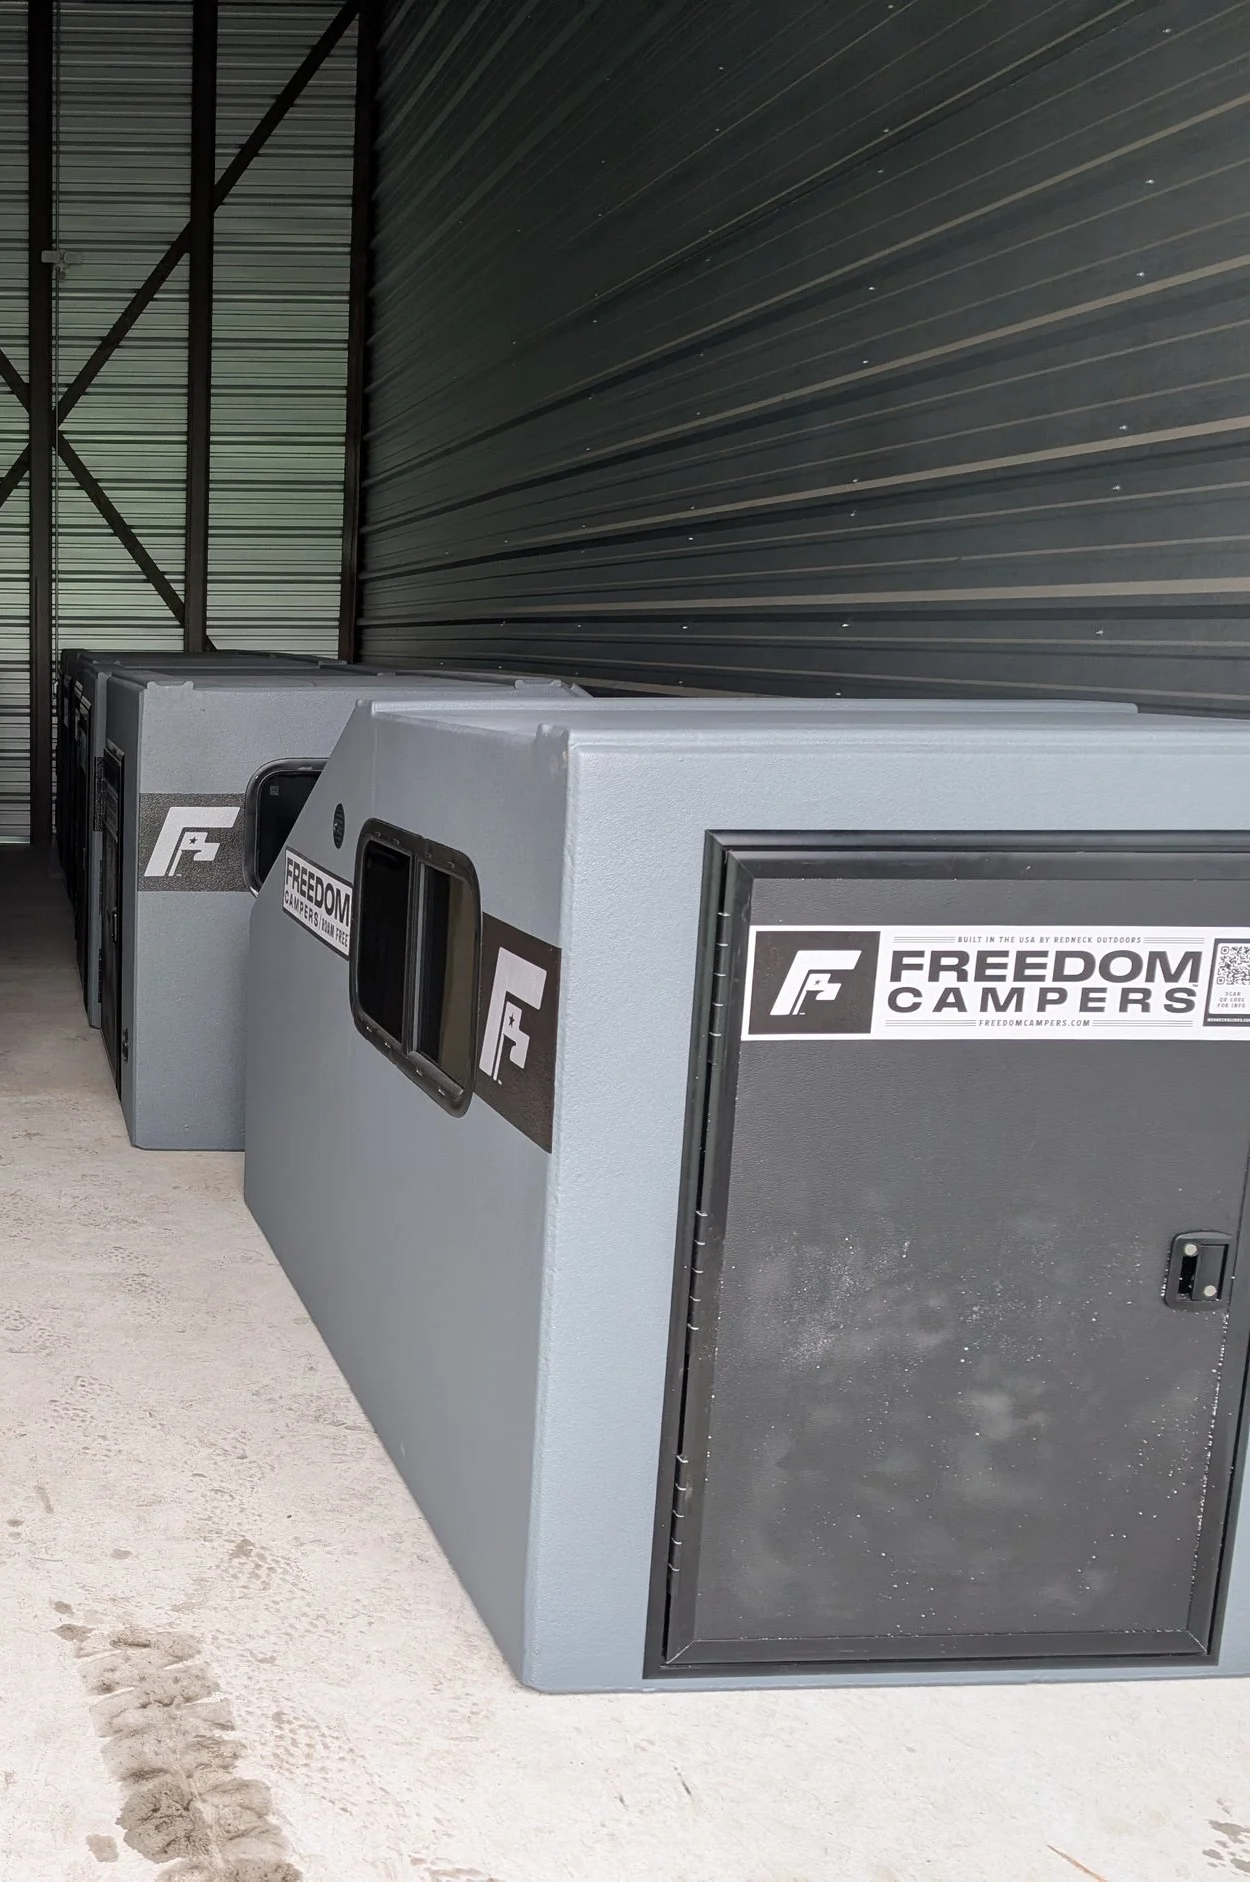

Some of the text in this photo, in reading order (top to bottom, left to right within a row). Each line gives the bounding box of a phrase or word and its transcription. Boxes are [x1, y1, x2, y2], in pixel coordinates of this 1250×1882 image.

[286, 857, 351, 927] FREEDOM
[336, 927, 349, 948] FREE
[957, 935, 1142, 944] BUILT IN THE USA BY REDNECK OUTDOORS
[889, 949, 1203, 983] FREEDOM
[887, 986, 1197, 1013] CAMPERS
[978, 1019, 1091, 1027] FREEDOMCAMPERS.COM
